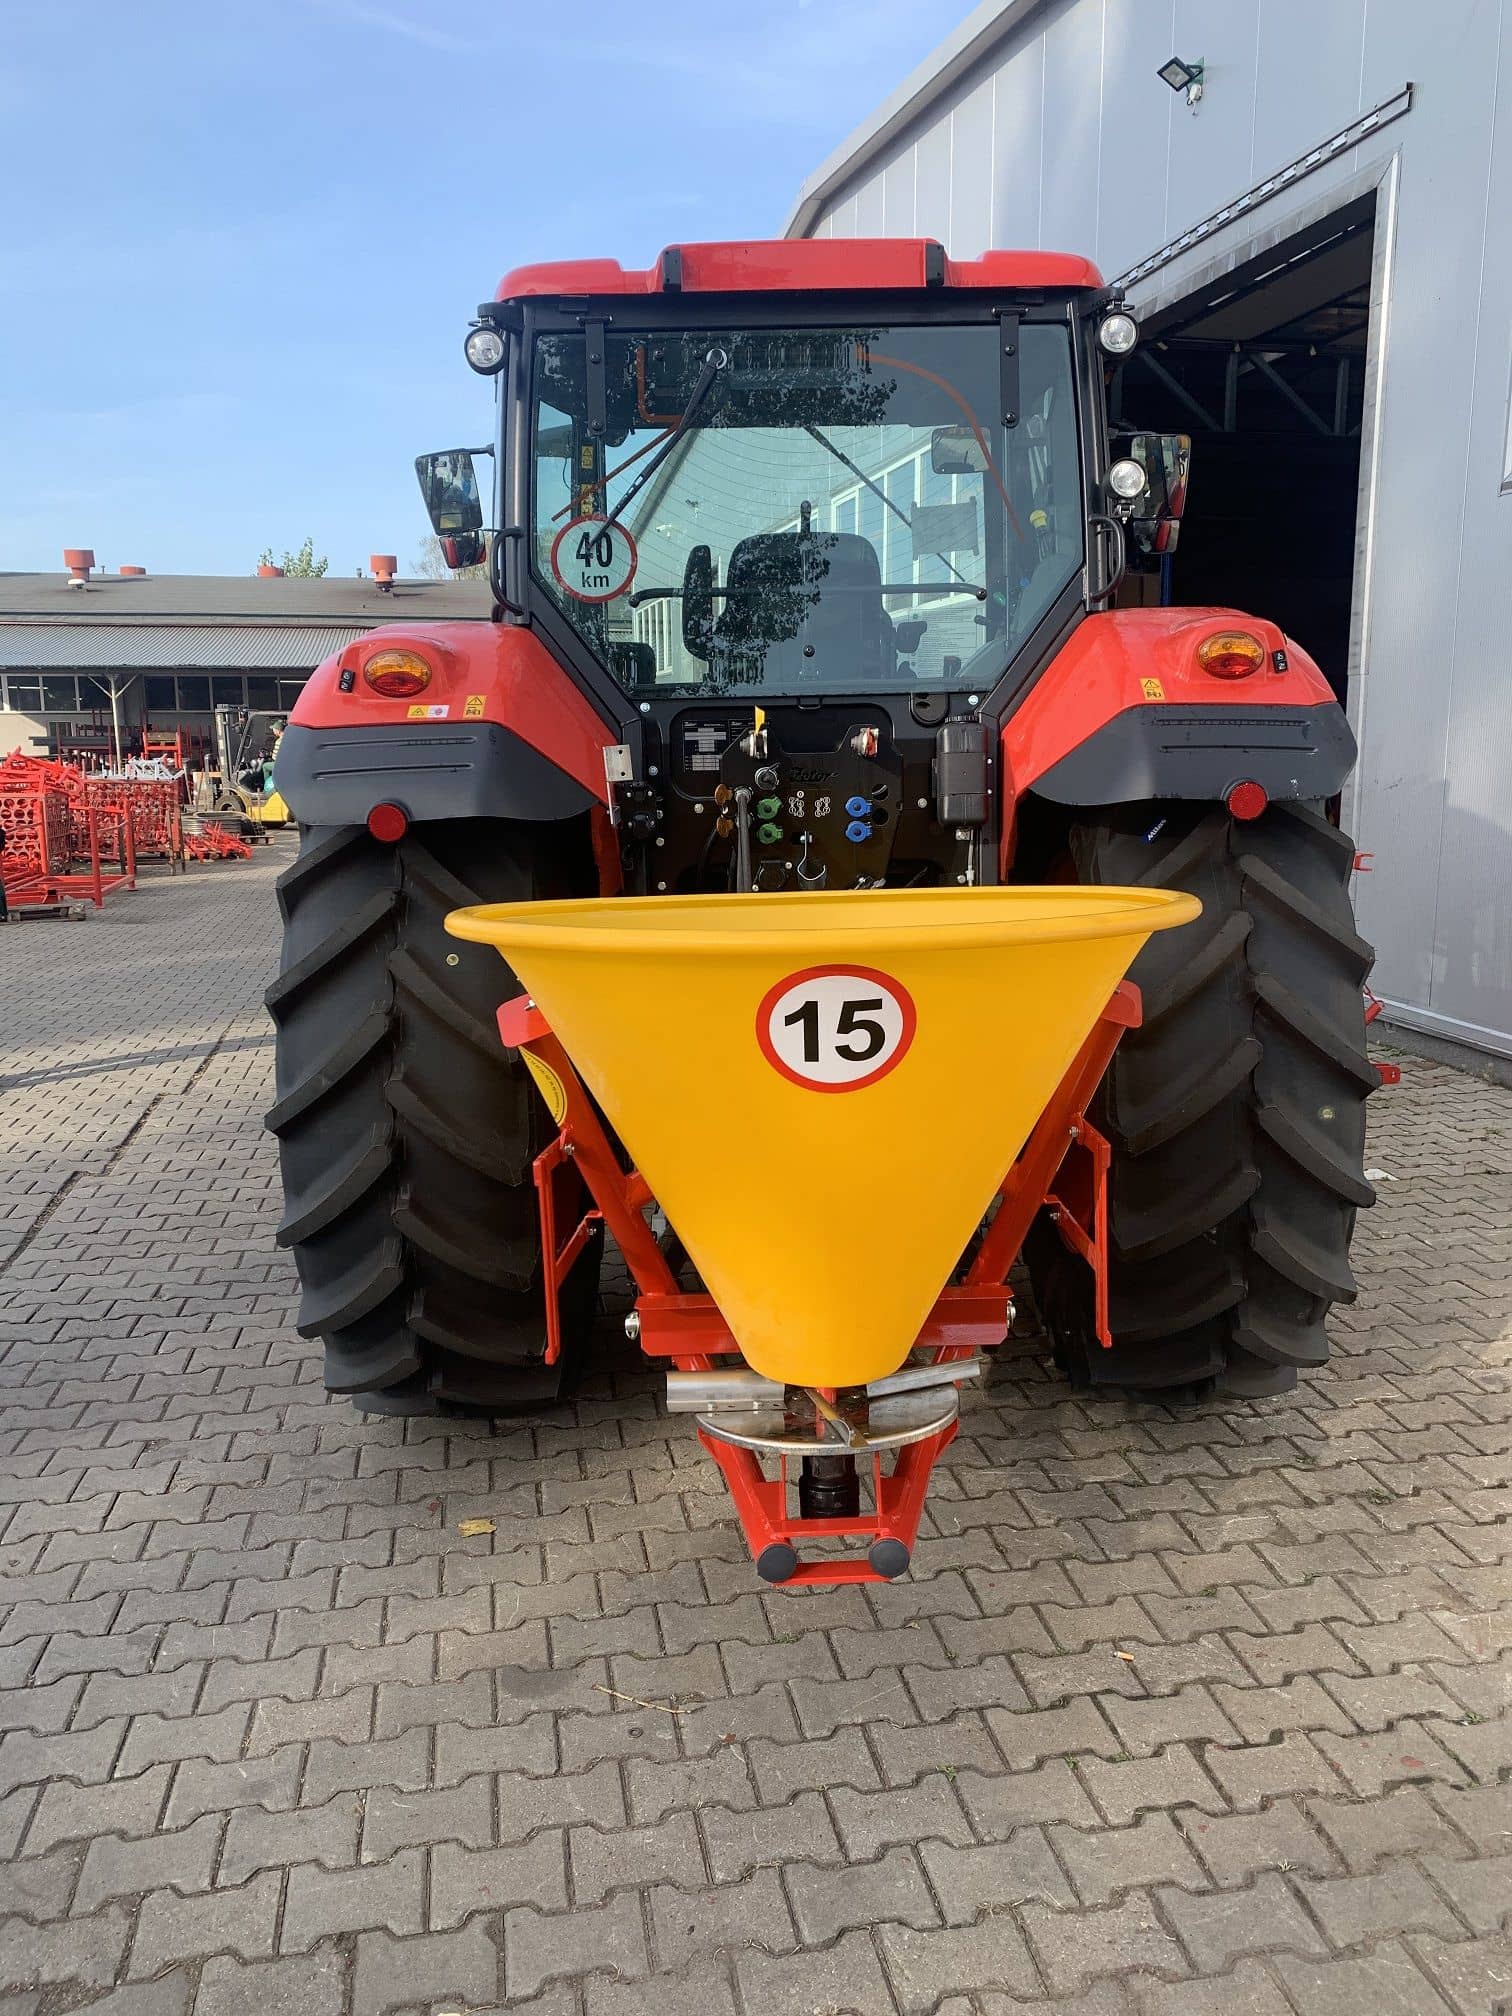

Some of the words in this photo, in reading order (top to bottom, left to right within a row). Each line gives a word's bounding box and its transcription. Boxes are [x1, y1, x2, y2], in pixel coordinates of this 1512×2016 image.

[576, 532, 613, 567] 40
[582, 572, 609, 587] km
[784, 999, 886, 1062] 15
